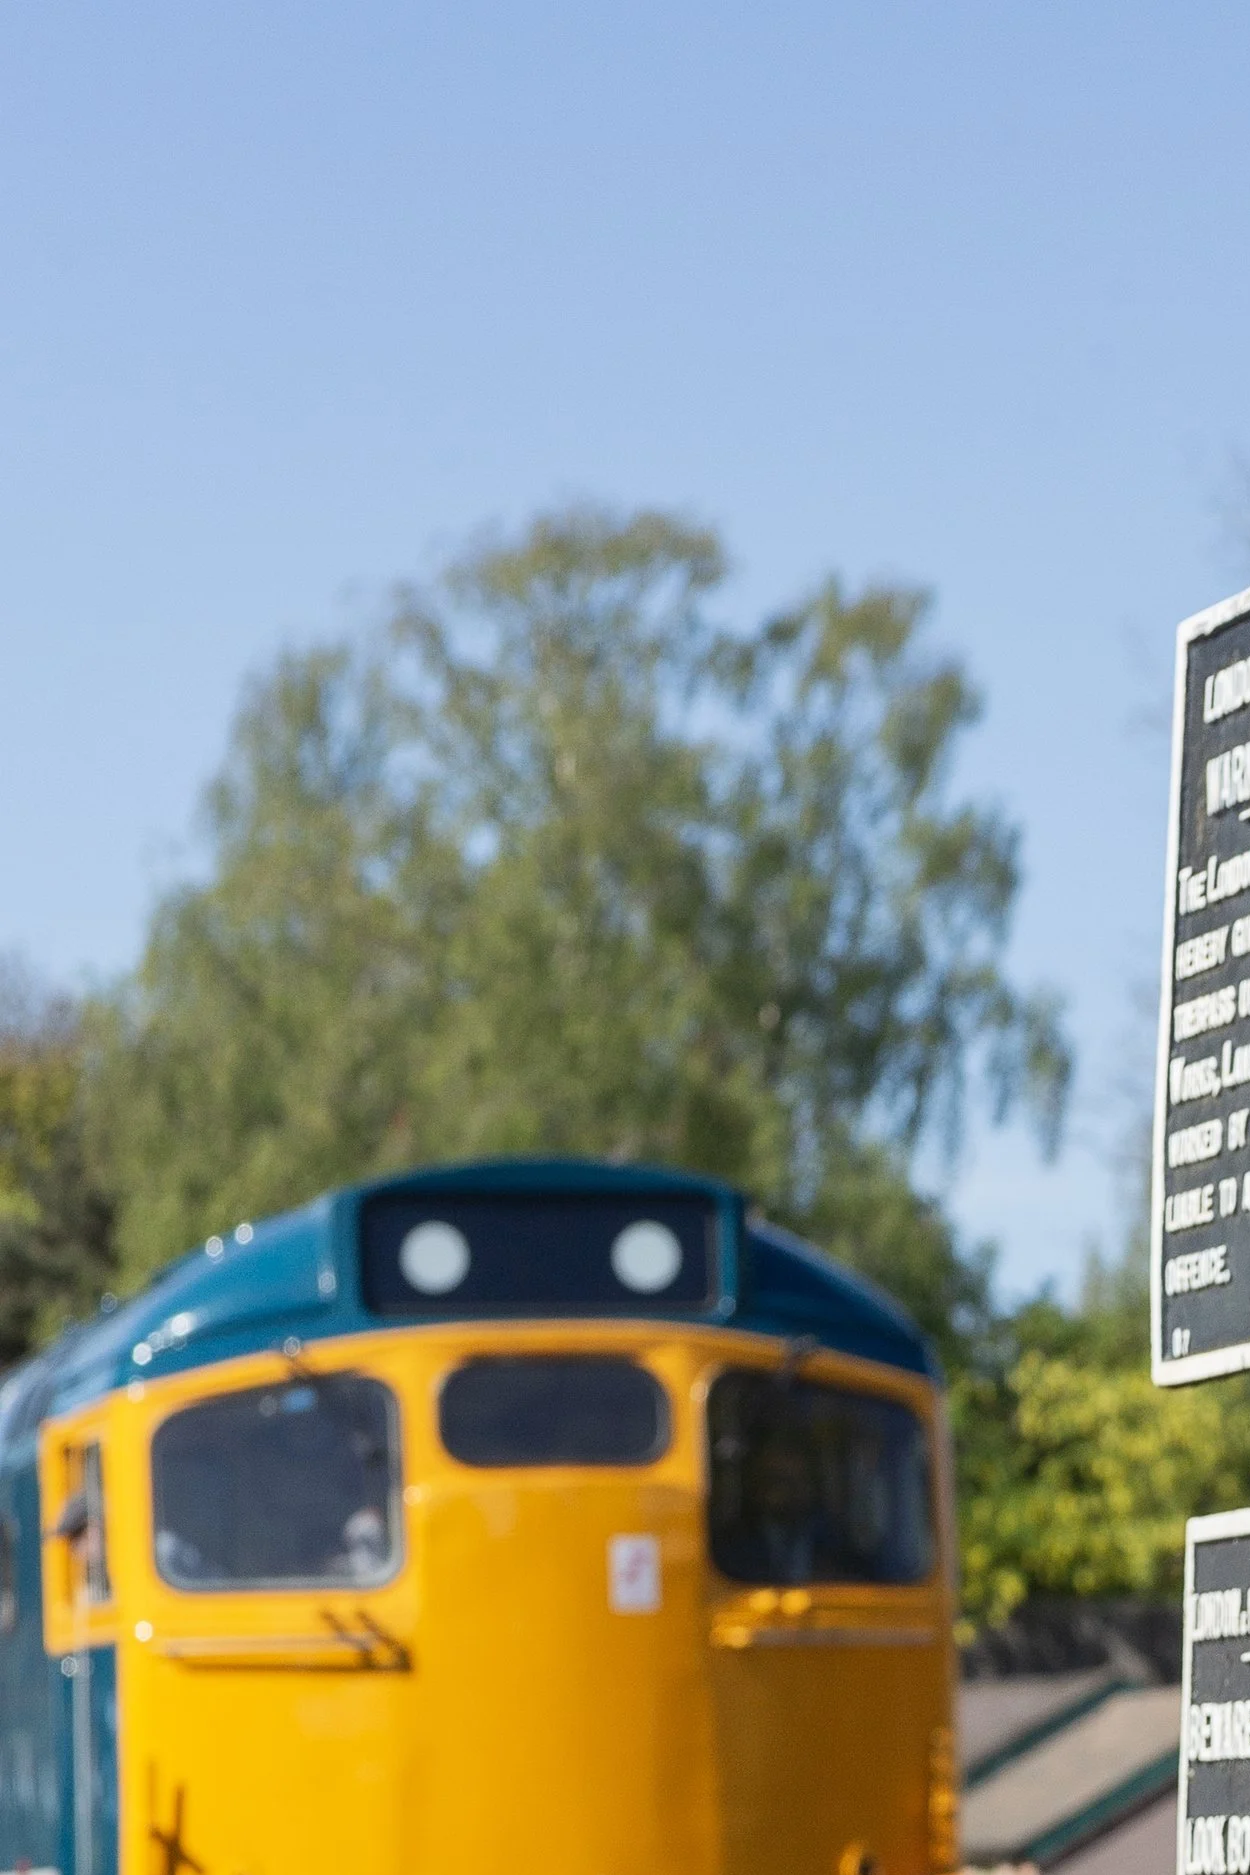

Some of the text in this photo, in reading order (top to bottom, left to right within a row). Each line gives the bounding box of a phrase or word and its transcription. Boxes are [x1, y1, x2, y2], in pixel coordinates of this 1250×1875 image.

[1179, 866, 1207, 917] THE
[1175, 925, 1229, 981] HEREBY
[1174, 985, 1237, 1043] TRESPASS
[1228, 1108, 1250, 1151] BY
[1165, 1184, 1214, 1232] LIABLE
[1219, 1177, 1237, 1218] TO
[1186, 1815, 1227, 1875] LOOK
